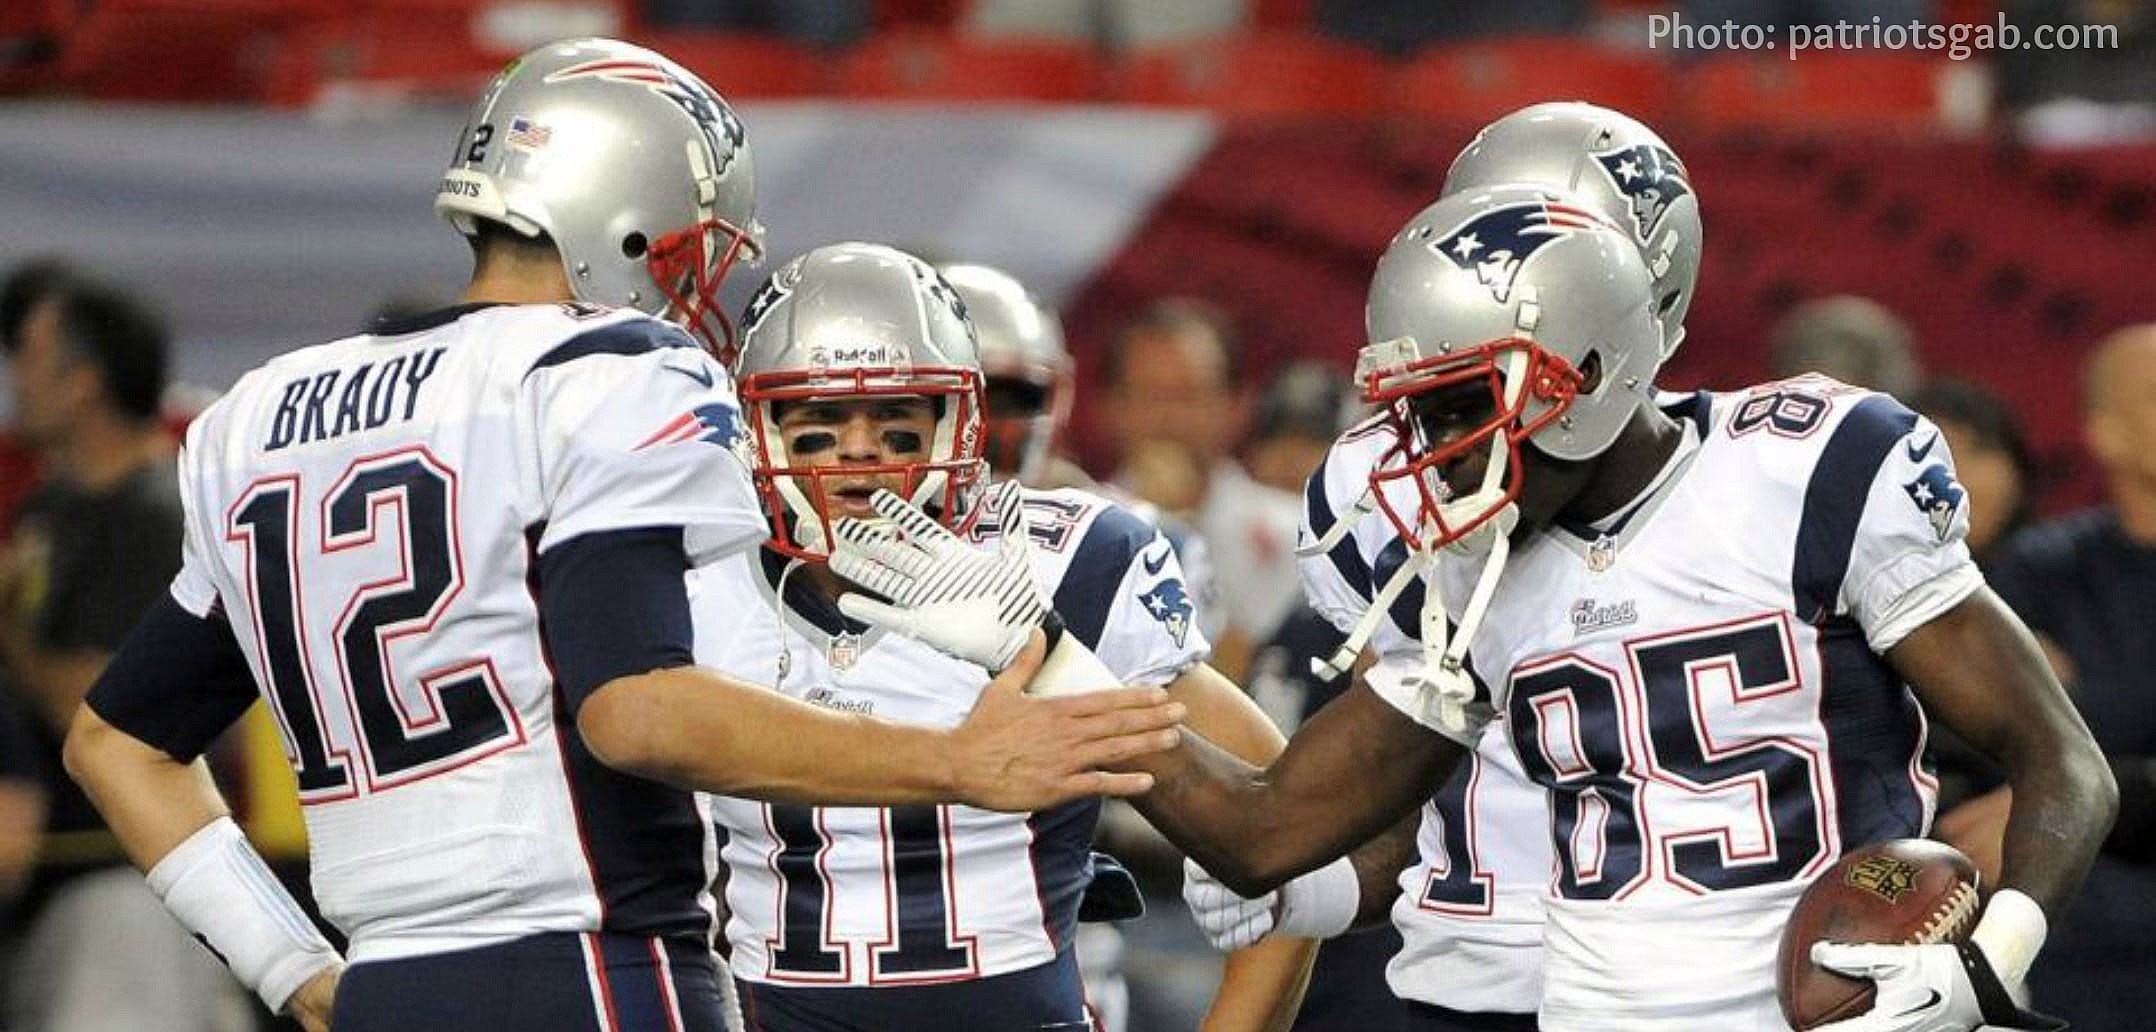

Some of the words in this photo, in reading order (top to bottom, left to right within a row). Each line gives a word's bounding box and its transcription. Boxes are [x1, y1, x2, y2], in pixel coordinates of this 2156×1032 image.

[264, 347, 448, 451] BRADY
[225, 443, 530, 806] 12
[1507, 610, 1838, 903] 85
[761, 801, 981, 985] 11
